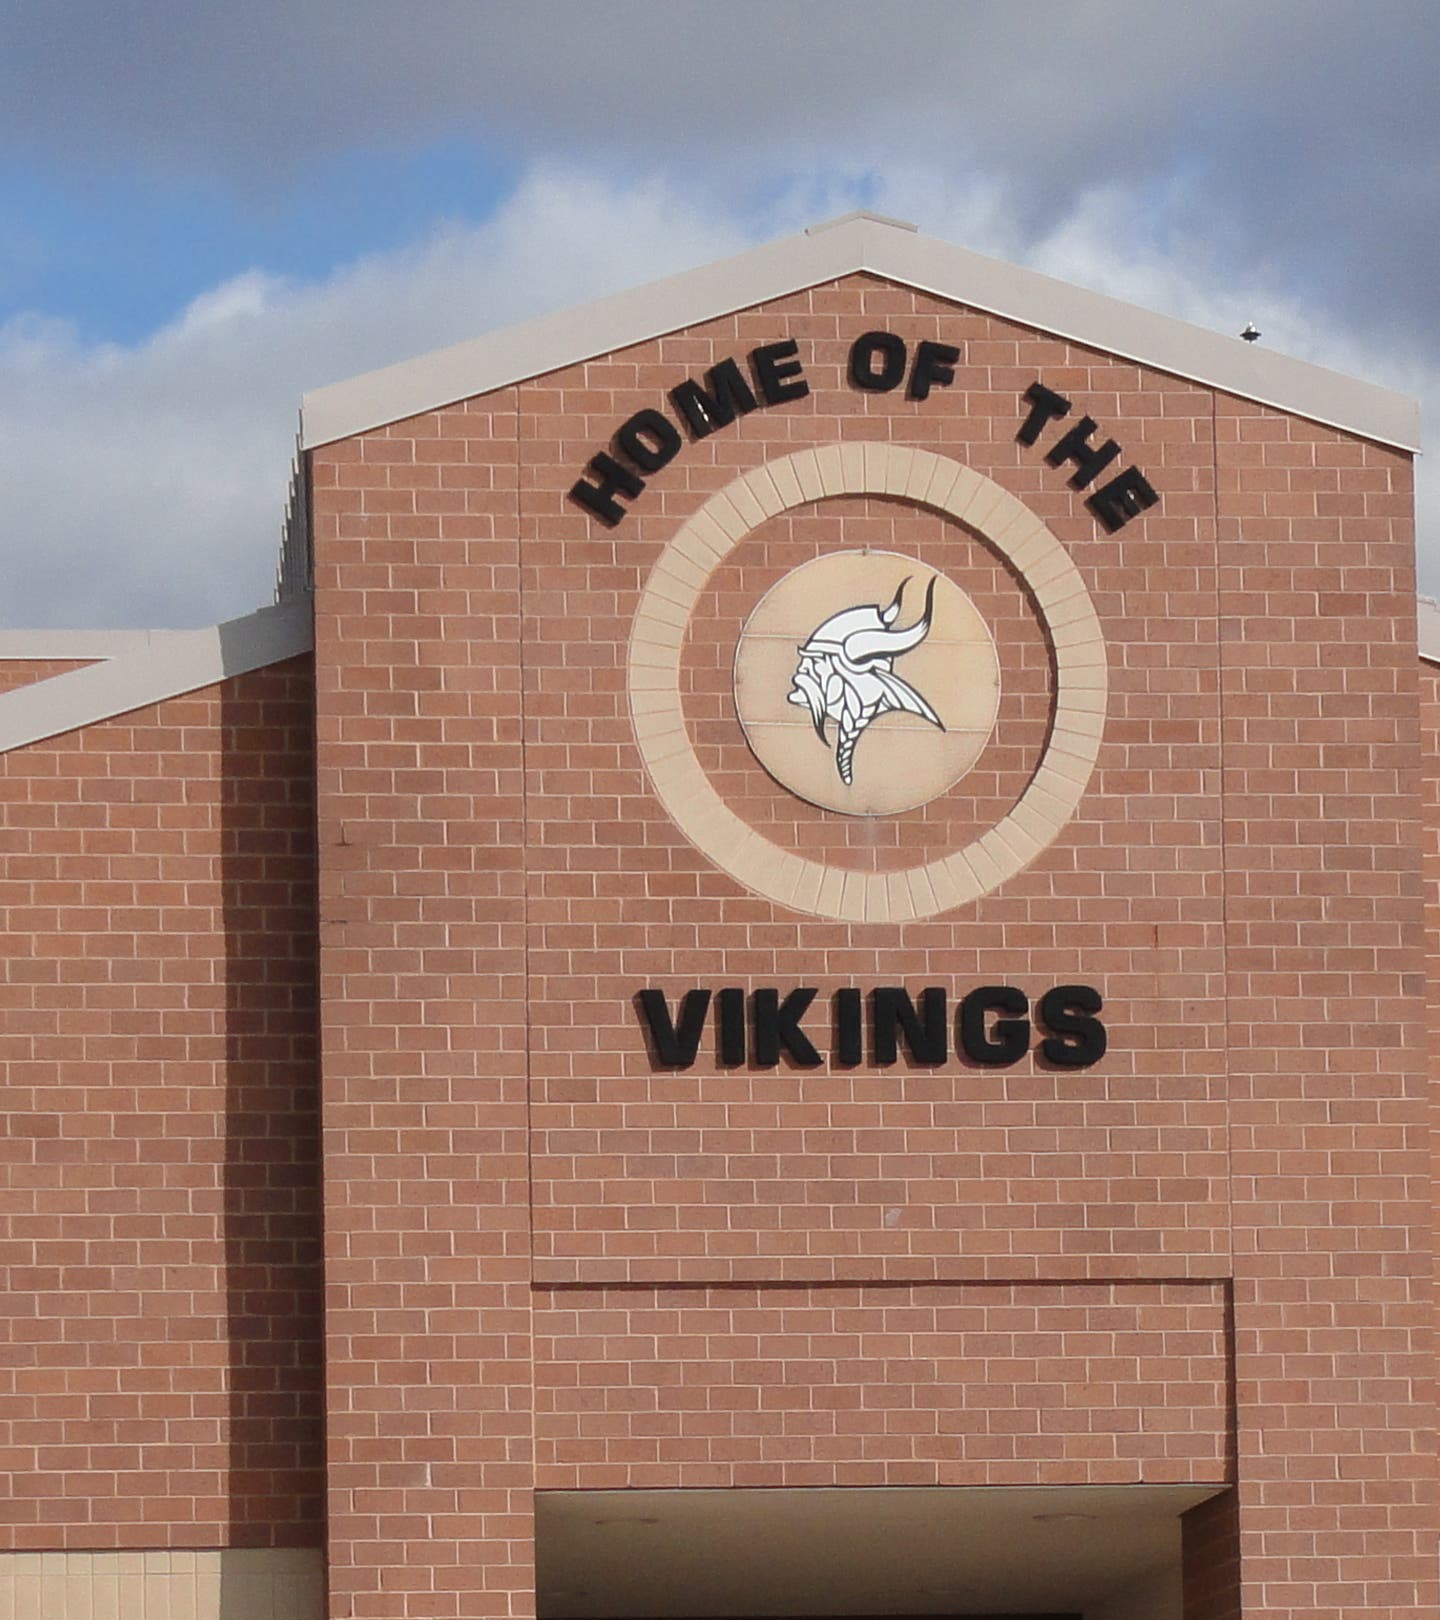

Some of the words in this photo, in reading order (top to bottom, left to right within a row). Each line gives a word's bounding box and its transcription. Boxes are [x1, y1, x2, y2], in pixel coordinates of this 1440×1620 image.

[567, 338, 809, 528] HOME
[848, 331, 960, 401] OF
[1015, 381, 1160, 535] THE
[635, 985, 1107, 1071] VIKINGS
